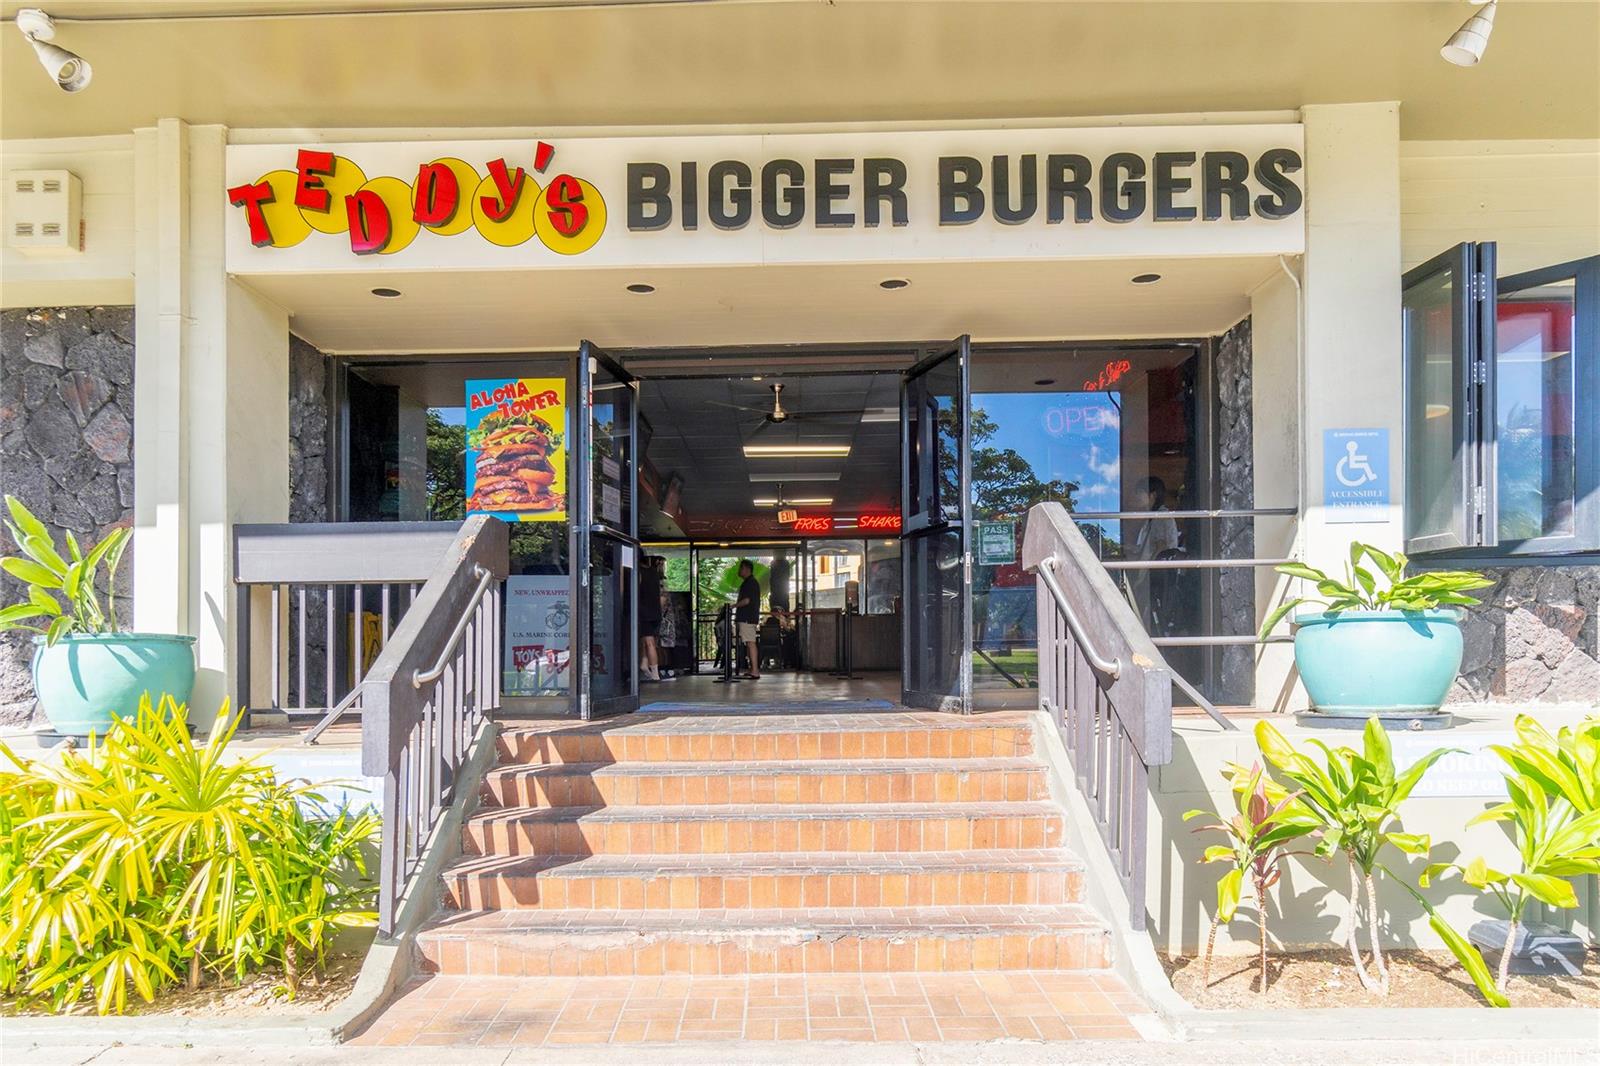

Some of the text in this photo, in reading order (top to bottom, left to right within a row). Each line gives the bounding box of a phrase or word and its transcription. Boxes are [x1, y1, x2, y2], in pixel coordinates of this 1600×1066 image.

[227, 141, 1303, 255] TEDDY'S BIGGER BURGERS
[470, 381, 531, 411] ALOHA
[497, 389, 561, 420] TOWER
[1330, 489, 1384, 498] ACCESSIBLE
[1332, 500, 1380, 509] ENTRANCE
[781, 510, 796, 522] EXIT
[794, 515, 902, 531] FRIES SHAKE
[983, 525, 1009, 534] PASS
[515, 648, 541, 663] TOYS
